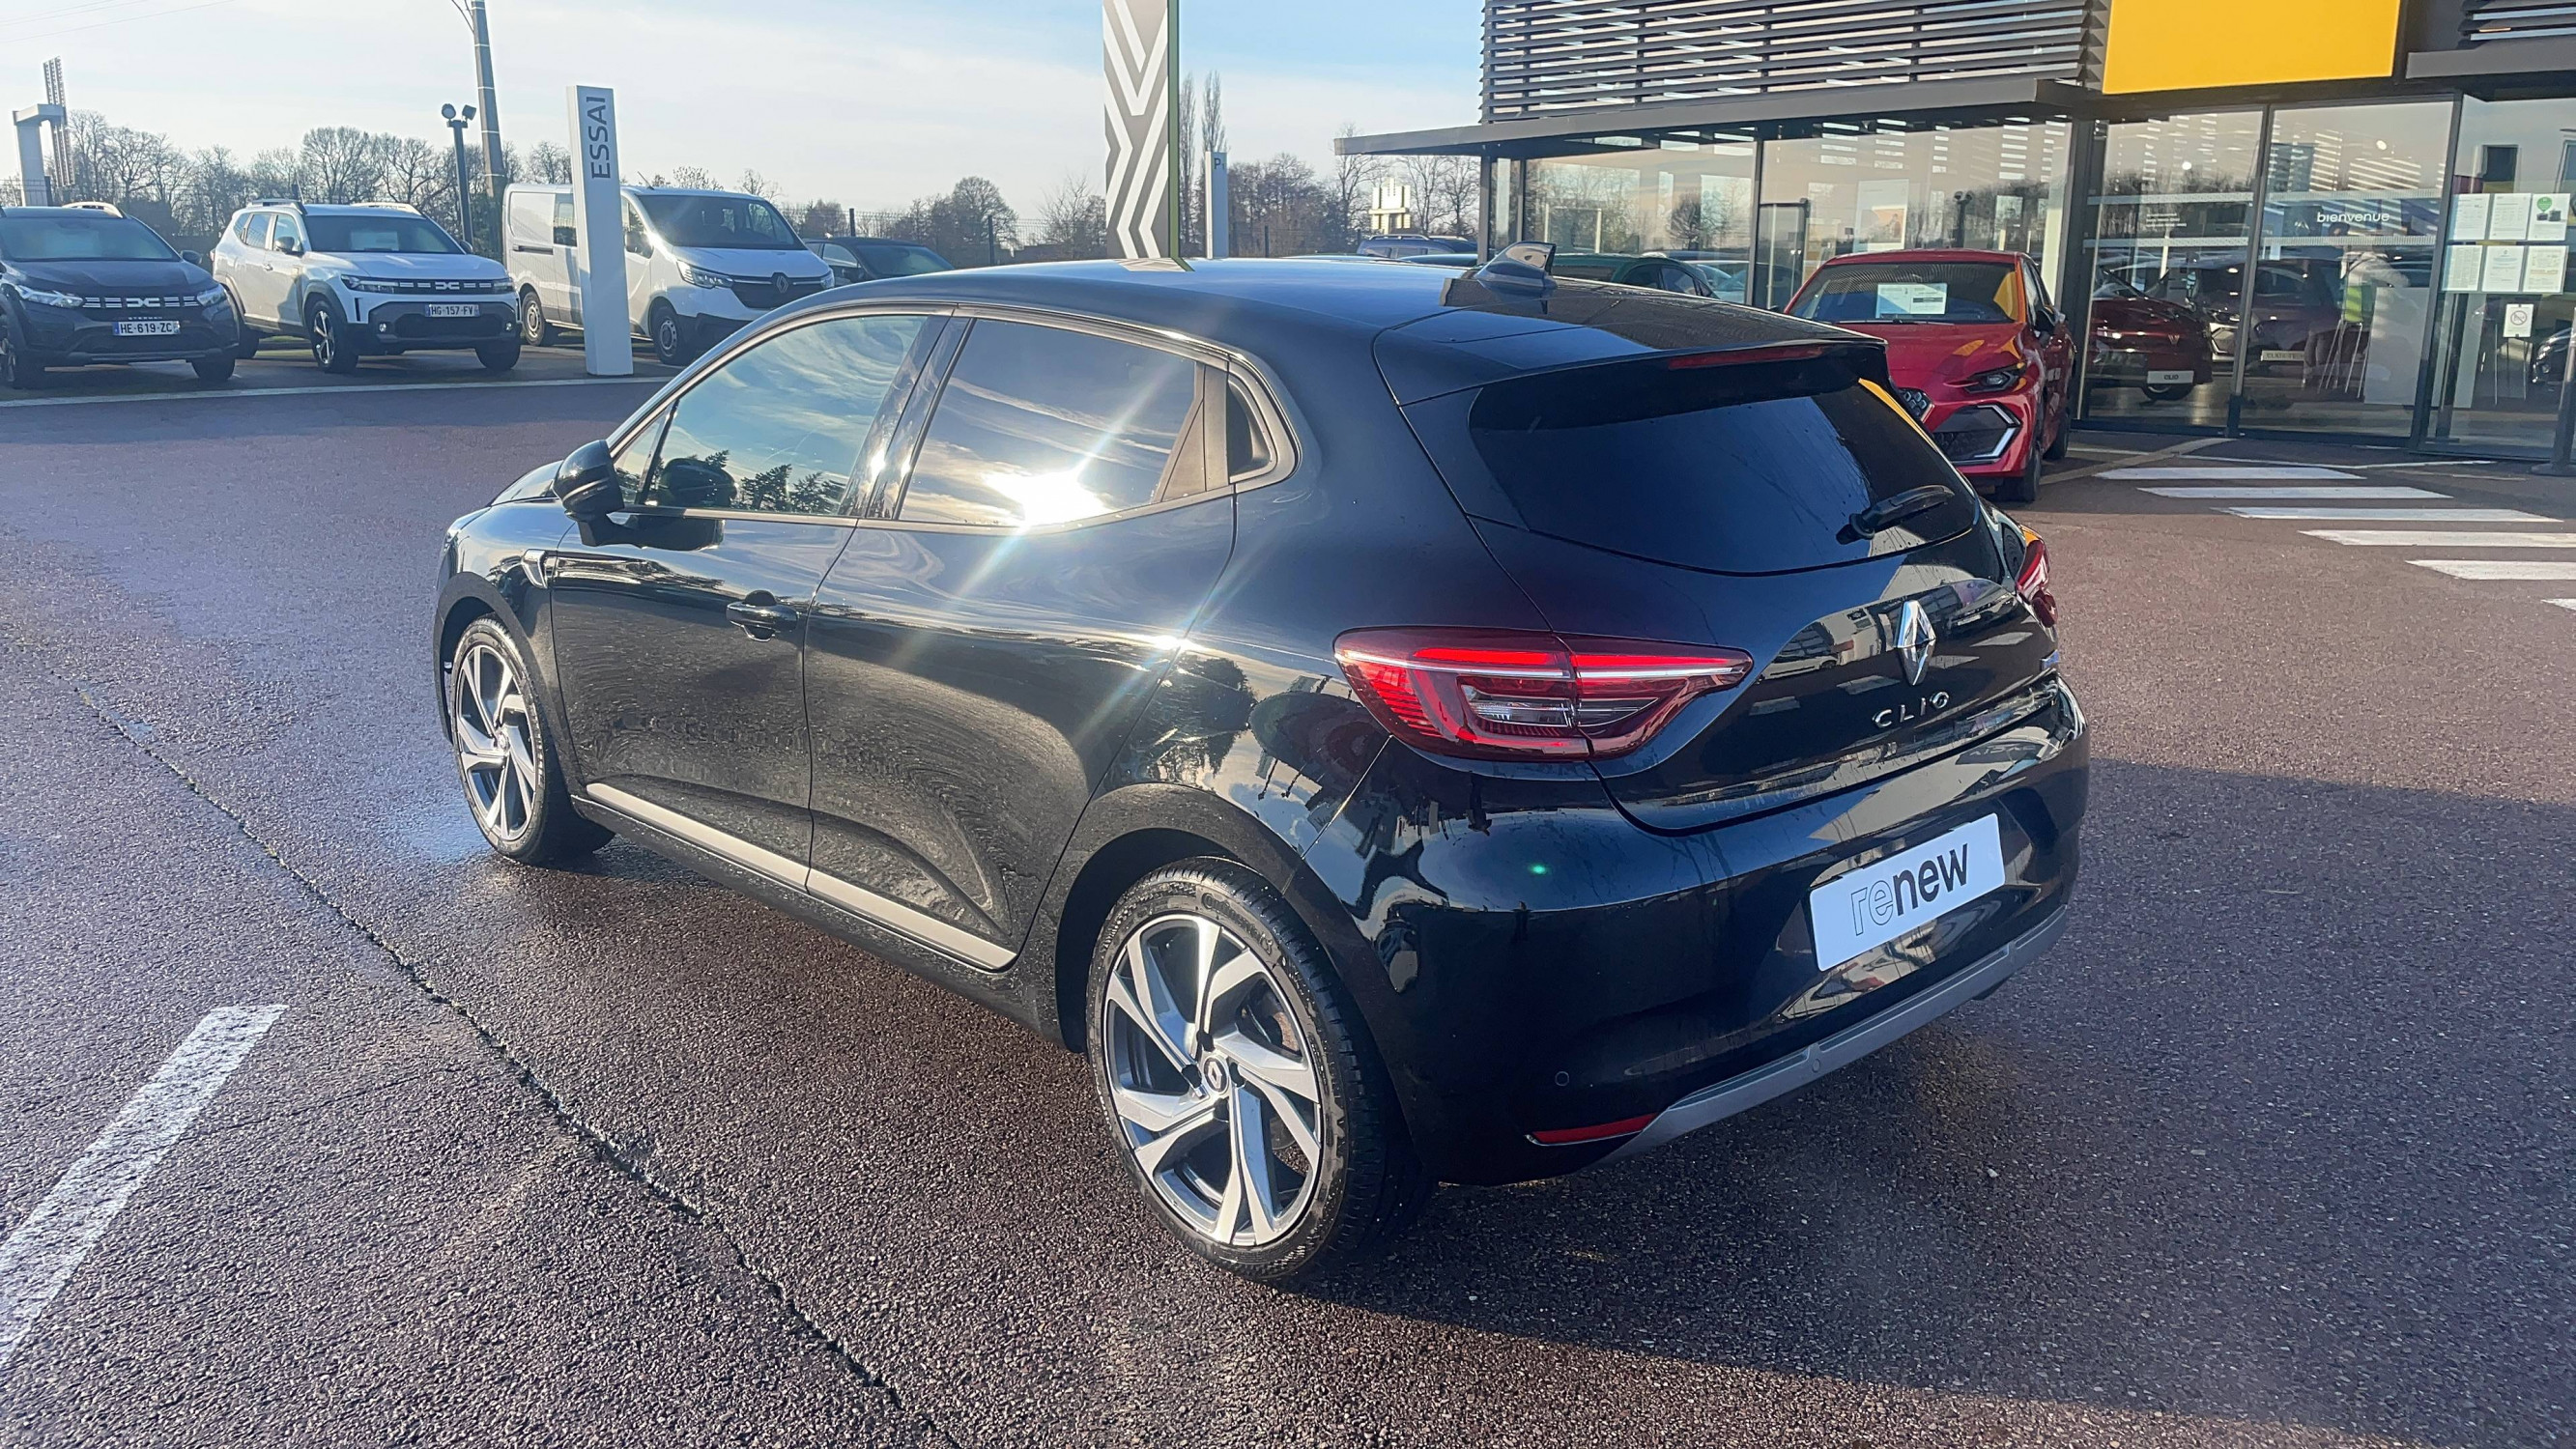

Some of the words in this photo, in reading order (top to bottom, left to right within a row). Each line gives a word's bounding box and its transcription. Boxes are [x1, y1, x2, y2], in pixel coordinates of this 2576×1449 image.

[586, 96, 612, 179] ESSAI
[2316, 212, 2391, 223] bienvenue
[120, 322, 173, 334] HE-619-ZC
[1872, 691, 1950, 728] CLIO
[1849, 842, 1968, 936] renew
